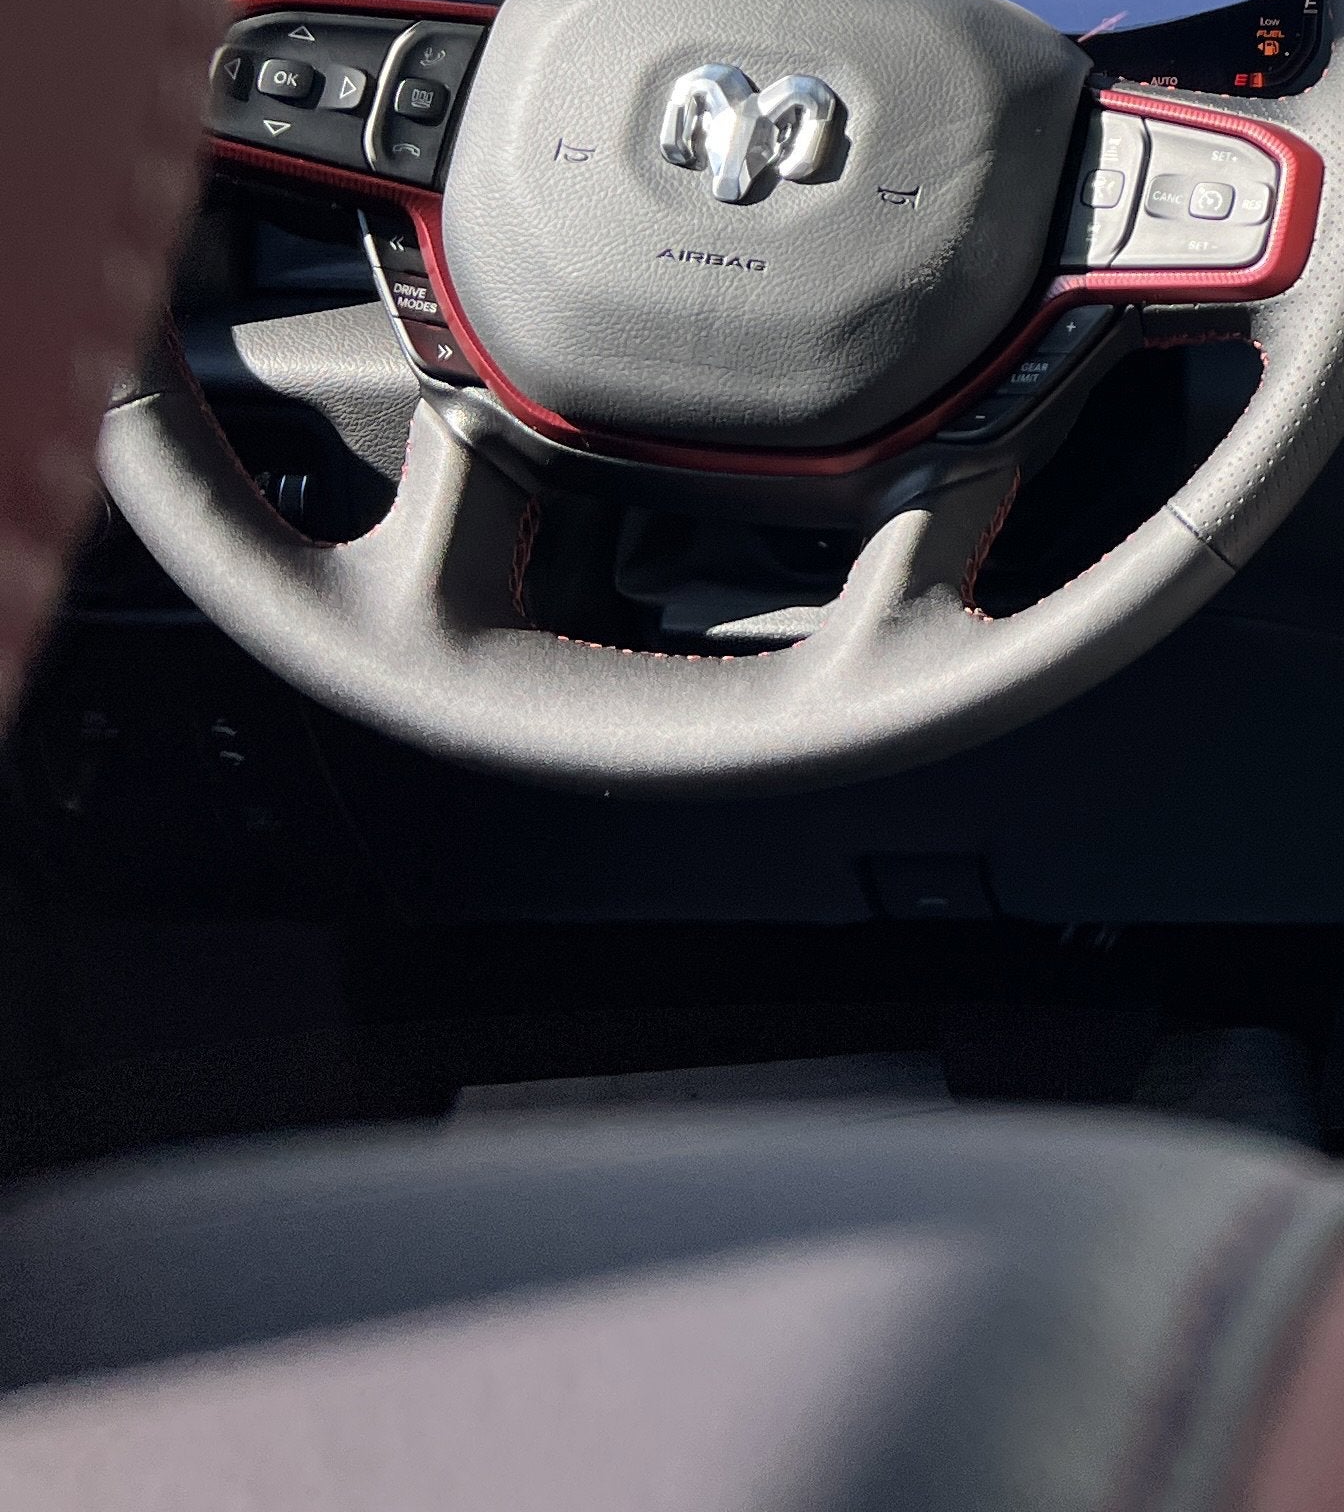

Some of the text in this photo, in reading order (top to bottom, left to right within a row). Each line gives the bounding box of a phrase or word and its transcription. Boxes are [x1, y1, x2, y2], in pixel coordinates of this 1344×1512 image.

[1256, 29, 1286, 40] FUEL
[273, 70, 299, 88] OK
[1149, 75, 1179, 88] AUTO
[1233, 73, 1250, 88] E
[1151, 190, 1185, 206] CANC
[1240, 198, 1264, 211] RES
[655, 247, 768, 273] AIRBAG
[393, 281, 428, 300] DRIVE
[396, 295, 439, 315] MODES
[1020, 361, 1050, 374] GEAR
[1009, 372, 1039, 385] LIMIT
